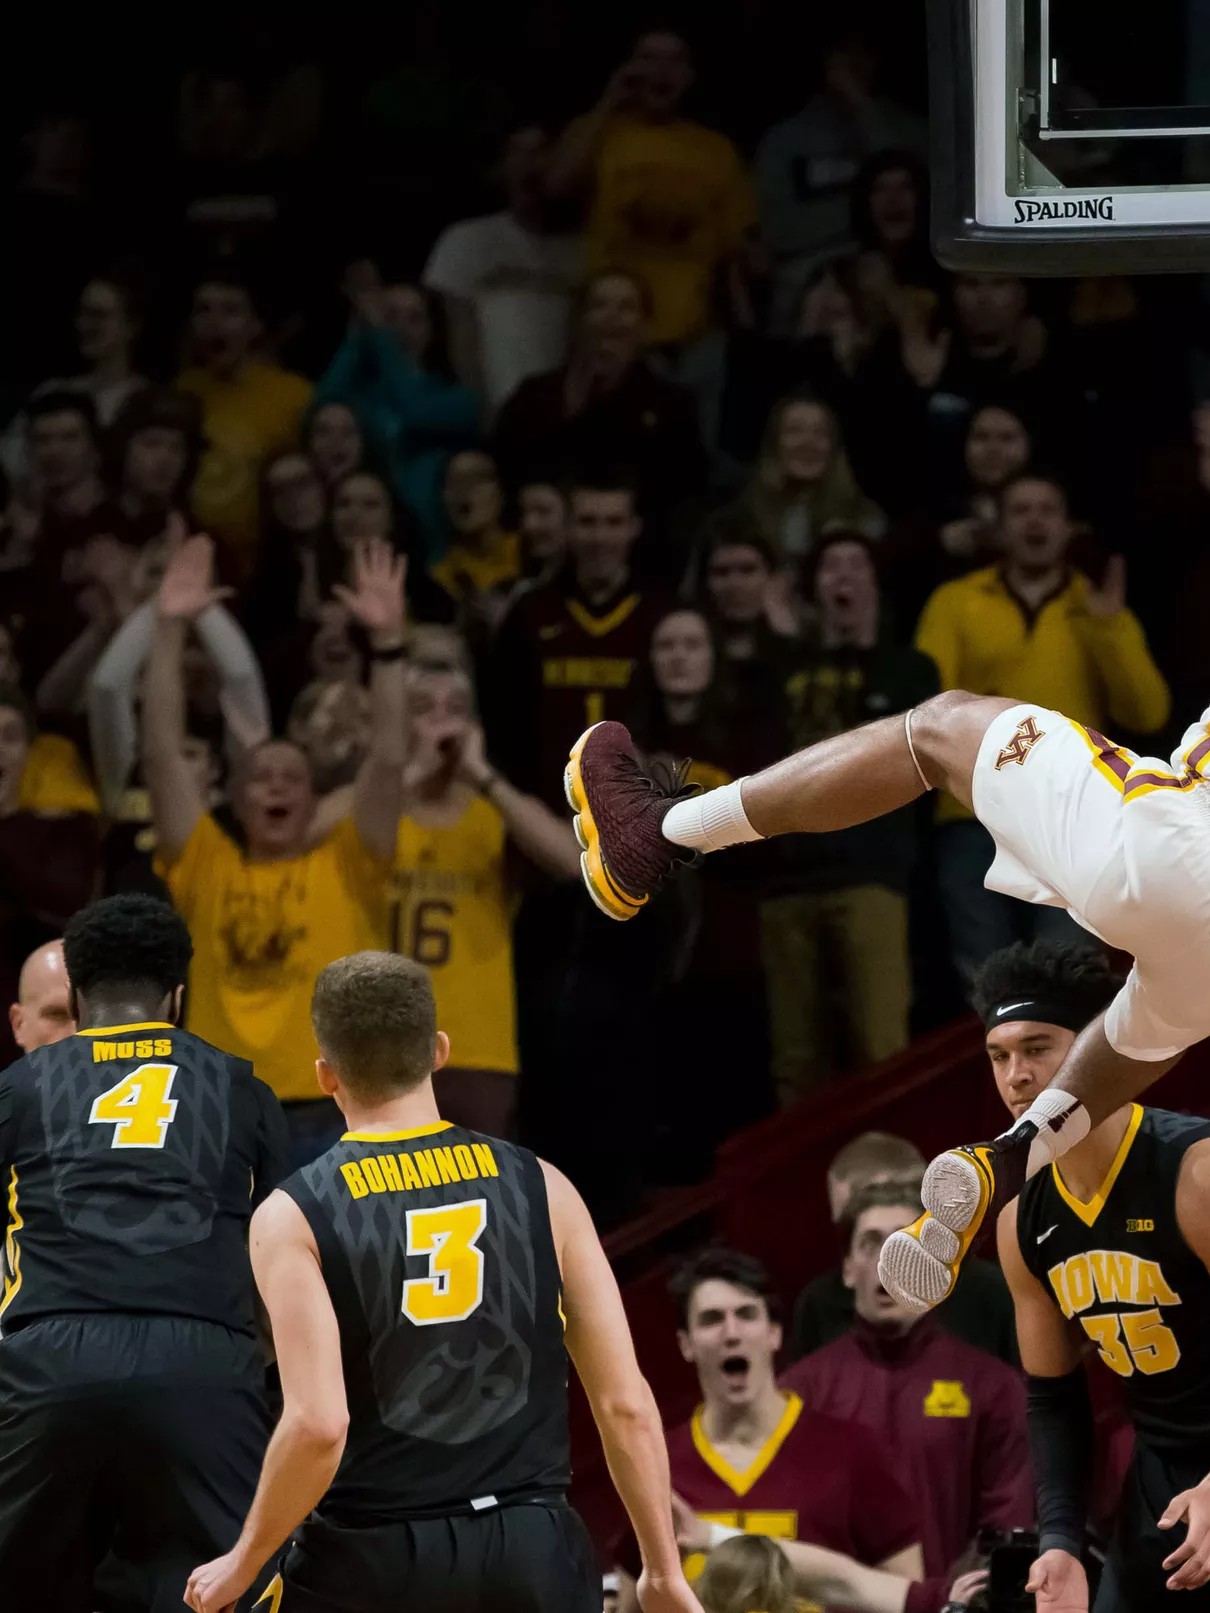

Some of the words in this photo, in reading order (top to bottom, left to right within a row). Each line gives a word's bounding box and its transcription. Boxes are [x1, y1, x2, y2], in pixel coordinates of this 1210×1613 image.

[1014, 196, 1114, 224] SPALDING
[93, 1039, 172, 1063] MOSS
[88, 1063, 179, 1149] 4
[339, 1143, 499, 1200] BOHANNON
[401, 1198, 488, 1326] 3
[1047, 1250, 1183, 1320] IOWA
[1079, 1308, 1181, 1377] 35
